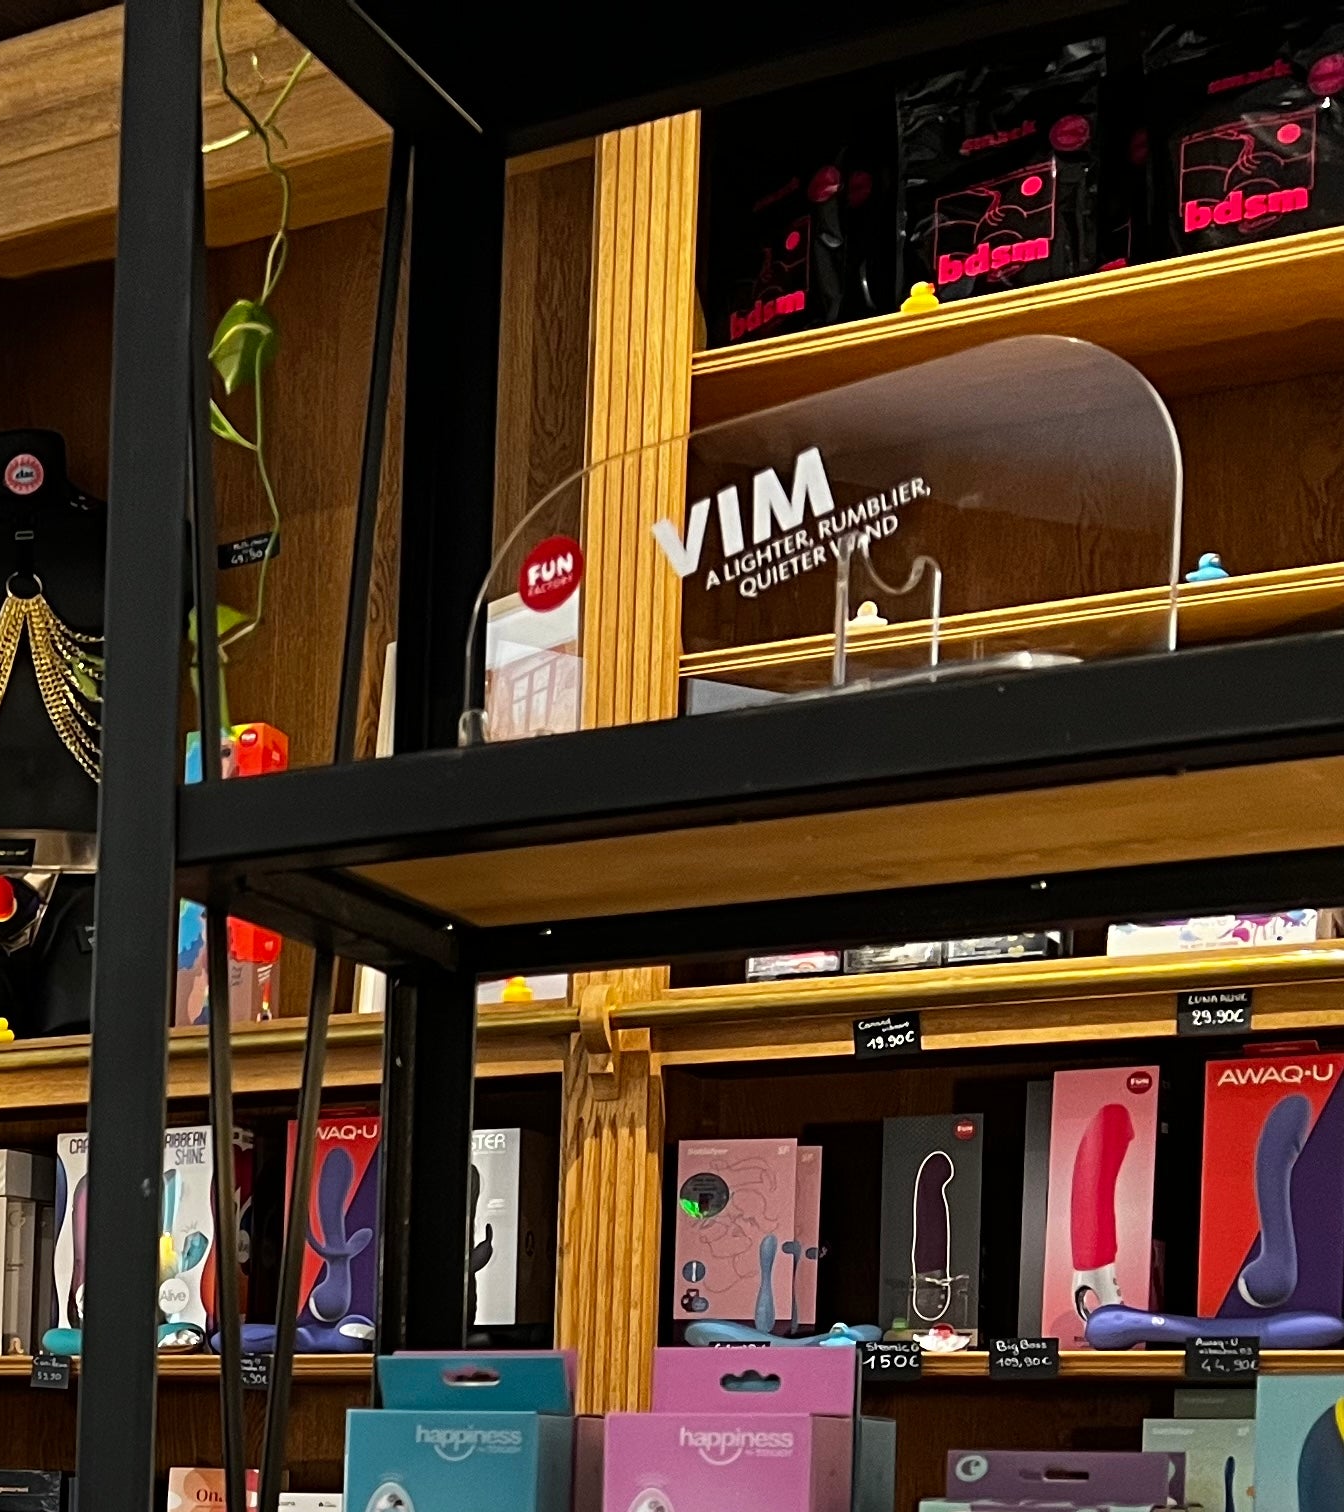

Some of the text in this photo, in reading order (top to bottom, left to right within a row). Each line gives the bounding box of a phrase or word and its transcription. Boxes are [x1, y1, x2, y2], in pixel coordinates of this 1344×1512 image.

[1184, 187, 1309, 233] bdsm
[938, 237, 1049, 286] bdsm
[730, 291, 805, 341] bdsm
[651, 446, 834, 578] VIM
[706, 477, 931, 591] A LIGHTER, RUMBLIER,
[525, 554, 575, 587] FUN
[739, 548, 827, 598] QUIETER
[863, 1354, 920, 1369] 150€
[416, 1425, 522, 1454] happiness
[680, 1427, 793, 1456] happiness
